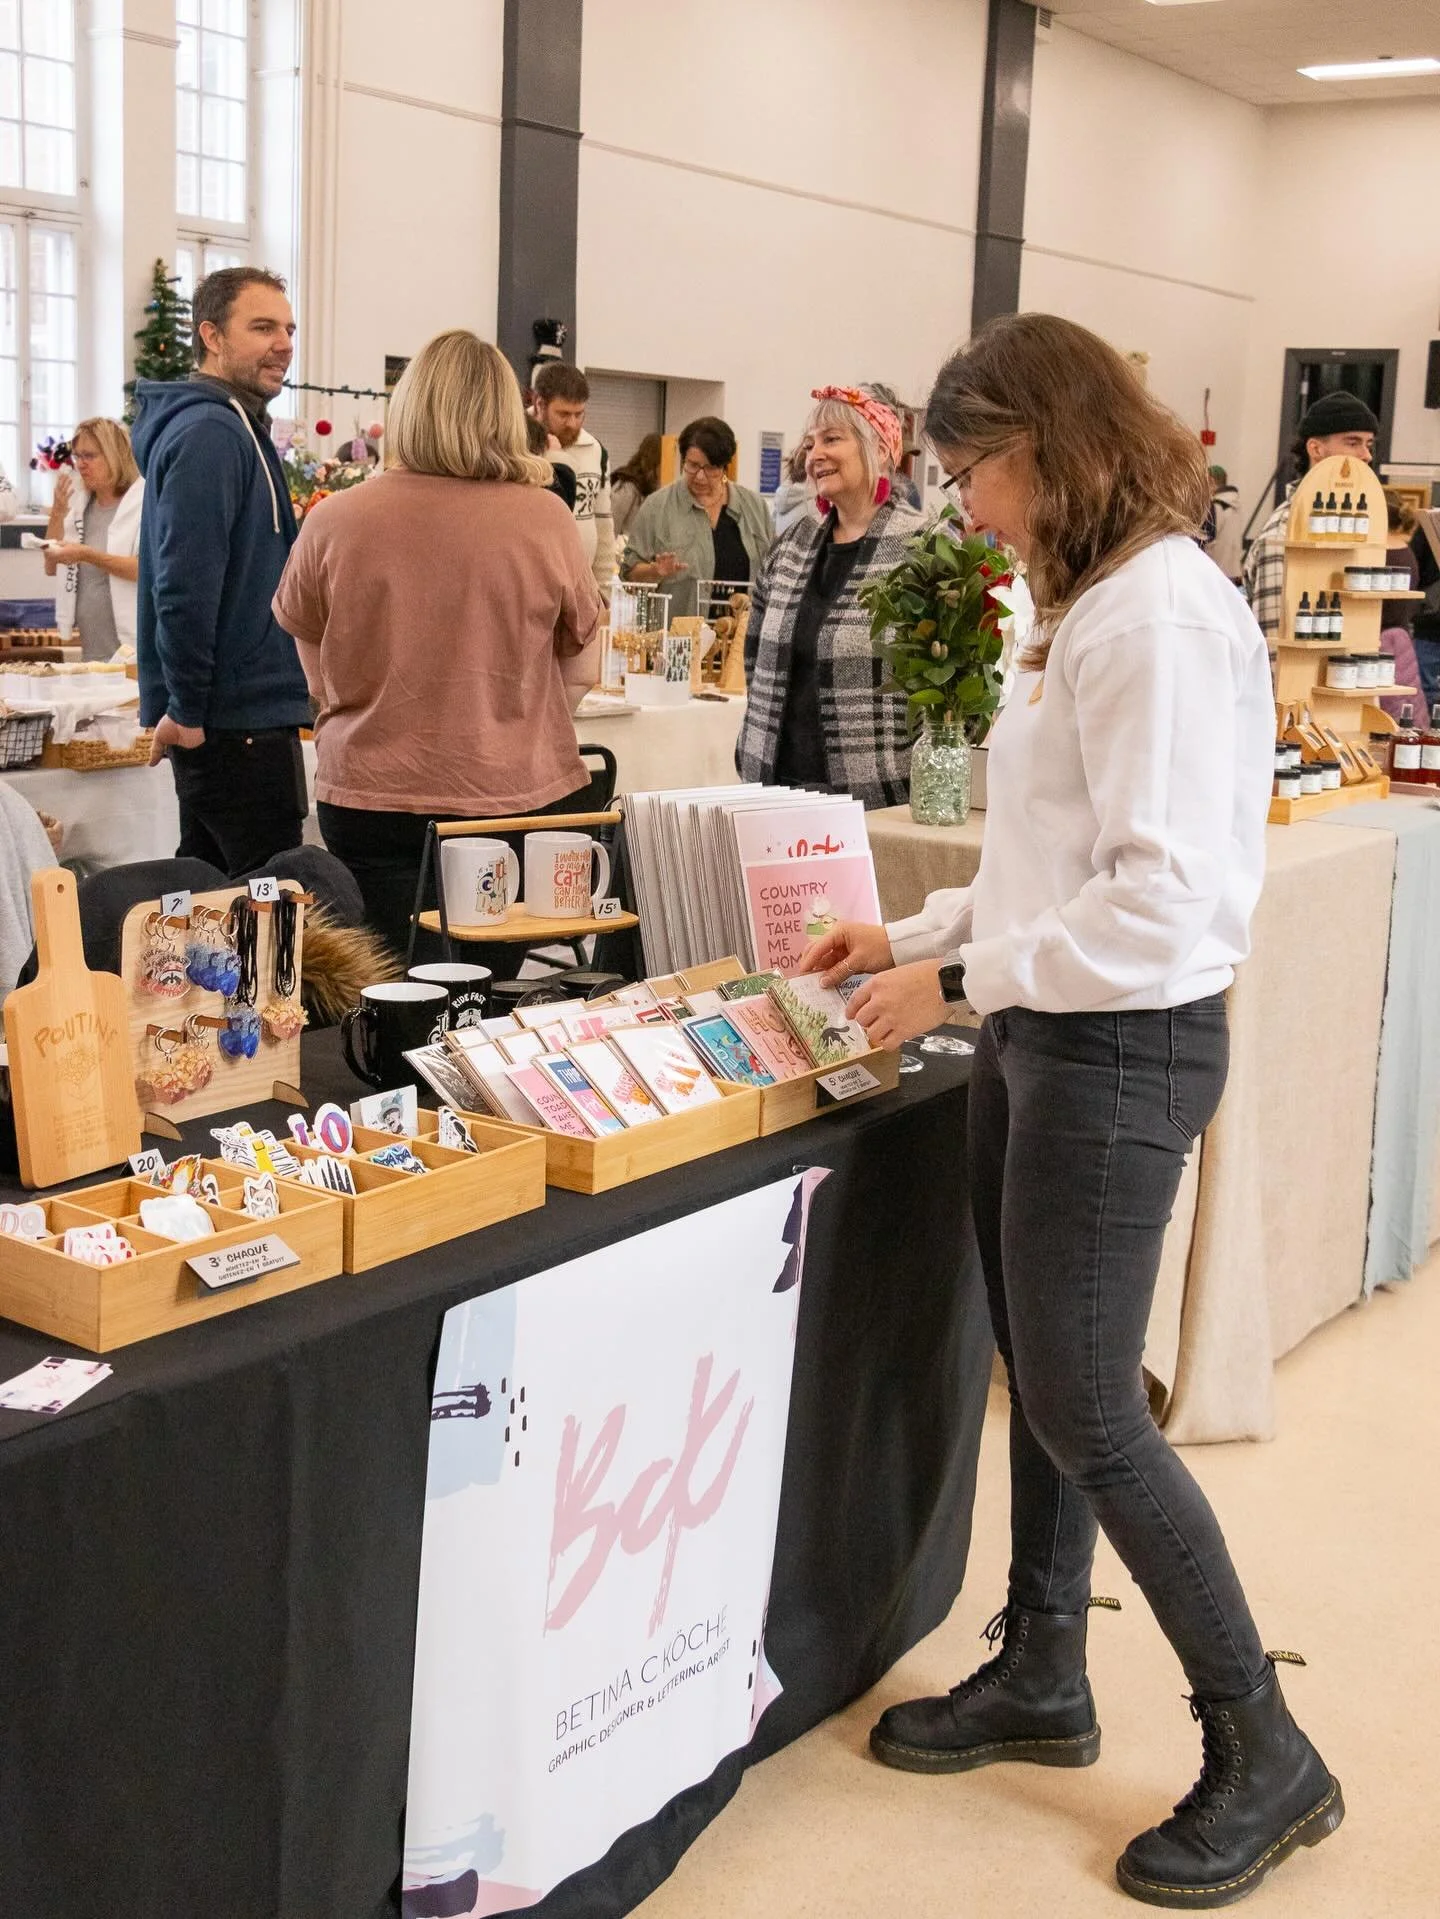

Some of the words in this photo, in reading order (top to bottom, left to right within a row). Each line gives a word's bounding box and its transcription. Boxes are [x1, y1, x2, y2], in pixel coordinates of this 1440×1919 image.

[760, 881, 828, 900] COUNTRY
[762, 902, 802, 918] TOAD
[765, 920, 802, 936] TAKE
[768, 938, 791, 953] ME
[770, 954, 802, 969] HOM
[451, 992, 469, 1009] RIDE
[470, 992, 487, 1005] FAST
[226, 1243, 269, 1263] CHAQUE
[556, 1668, 632, 1741] BETINA
[641, 1655, 658, 1684] C
[662, 1603, 728, 1673] KÖCHE
[548, 1734, 597, 1774] GRAPHIC
[599, 1700, 644, 1743] DESIGNER
[647, 1696, 655, 1709] &
[657, 1660, 705, 1704] LETTERING
